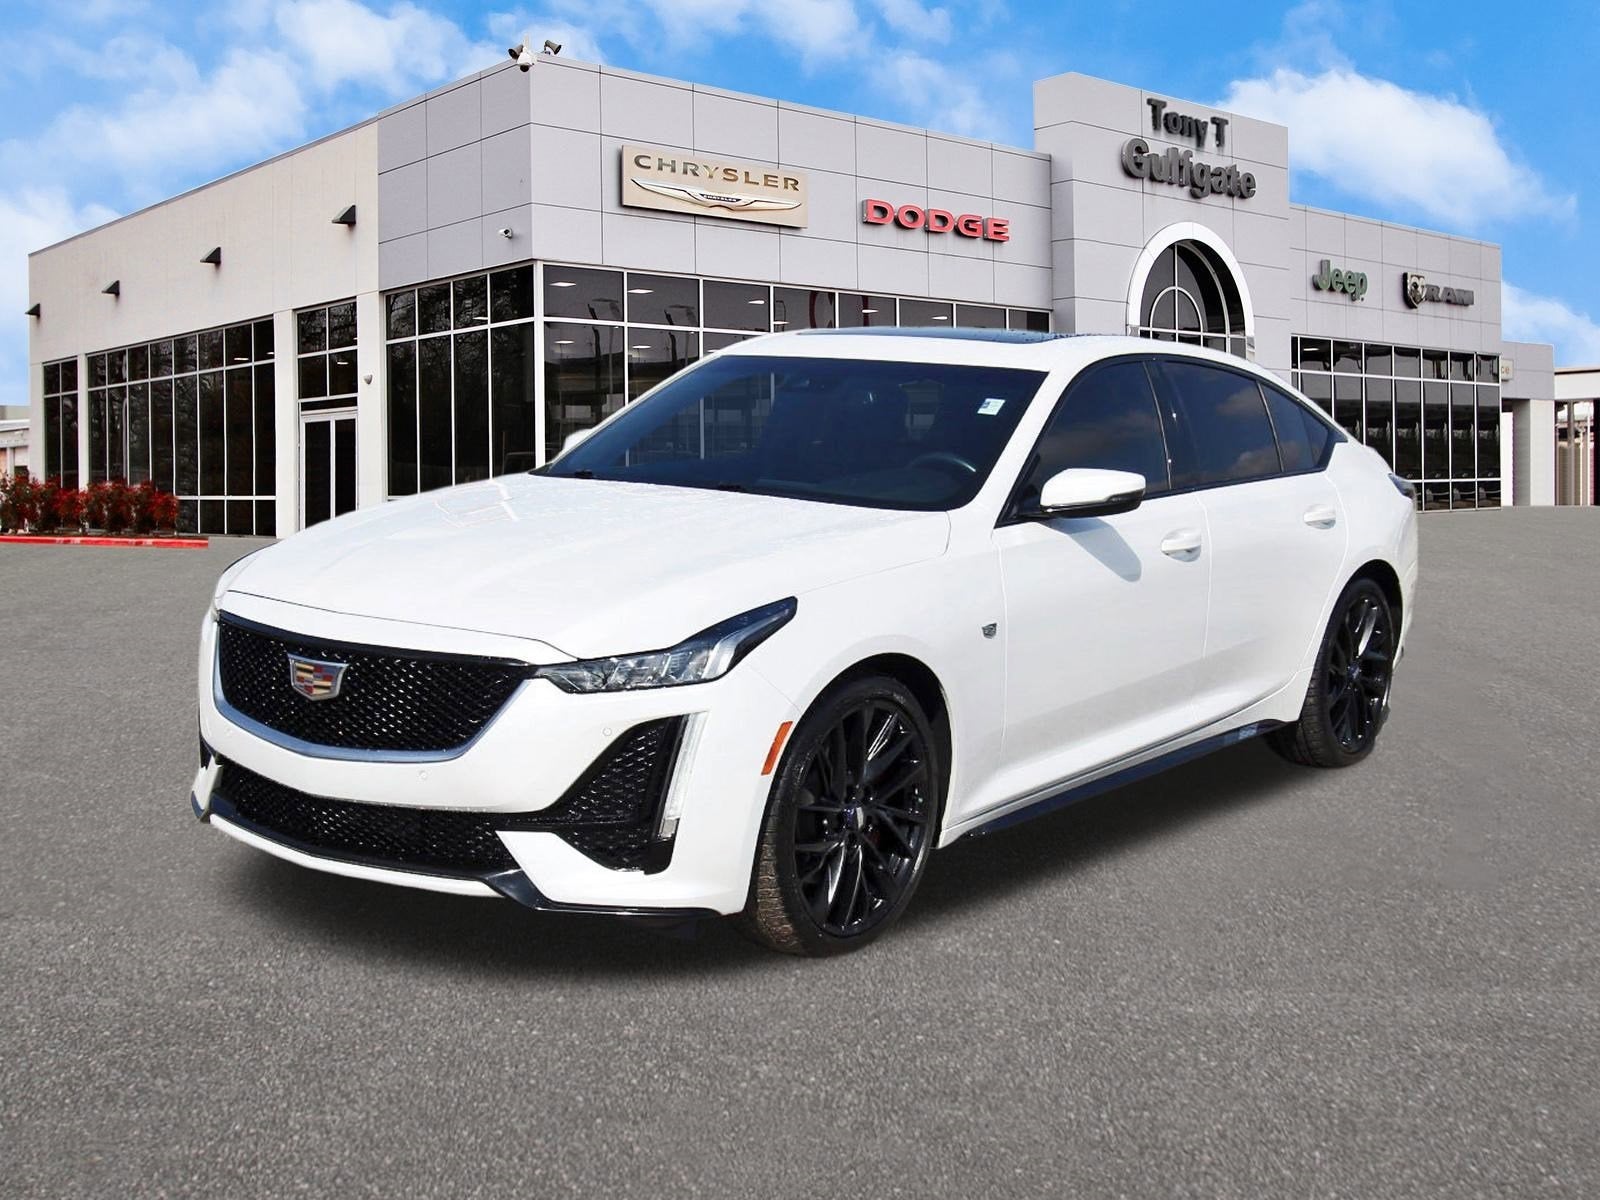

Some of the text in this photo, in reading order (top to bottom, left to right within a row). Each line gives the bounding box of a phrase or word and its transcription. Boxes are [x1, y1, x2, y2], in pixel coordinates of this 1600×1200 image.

[1147, 98, 1229, 147] Tony T
[634, 154, 800, 191] CHRYSLER
[1121, 138, 1256, 198] Gulfgate
[863, 199, 1009, 242] DODGE
[1312, 259, 1367, 301] Jeep
[1425, 284, 1474, 306] RAM
